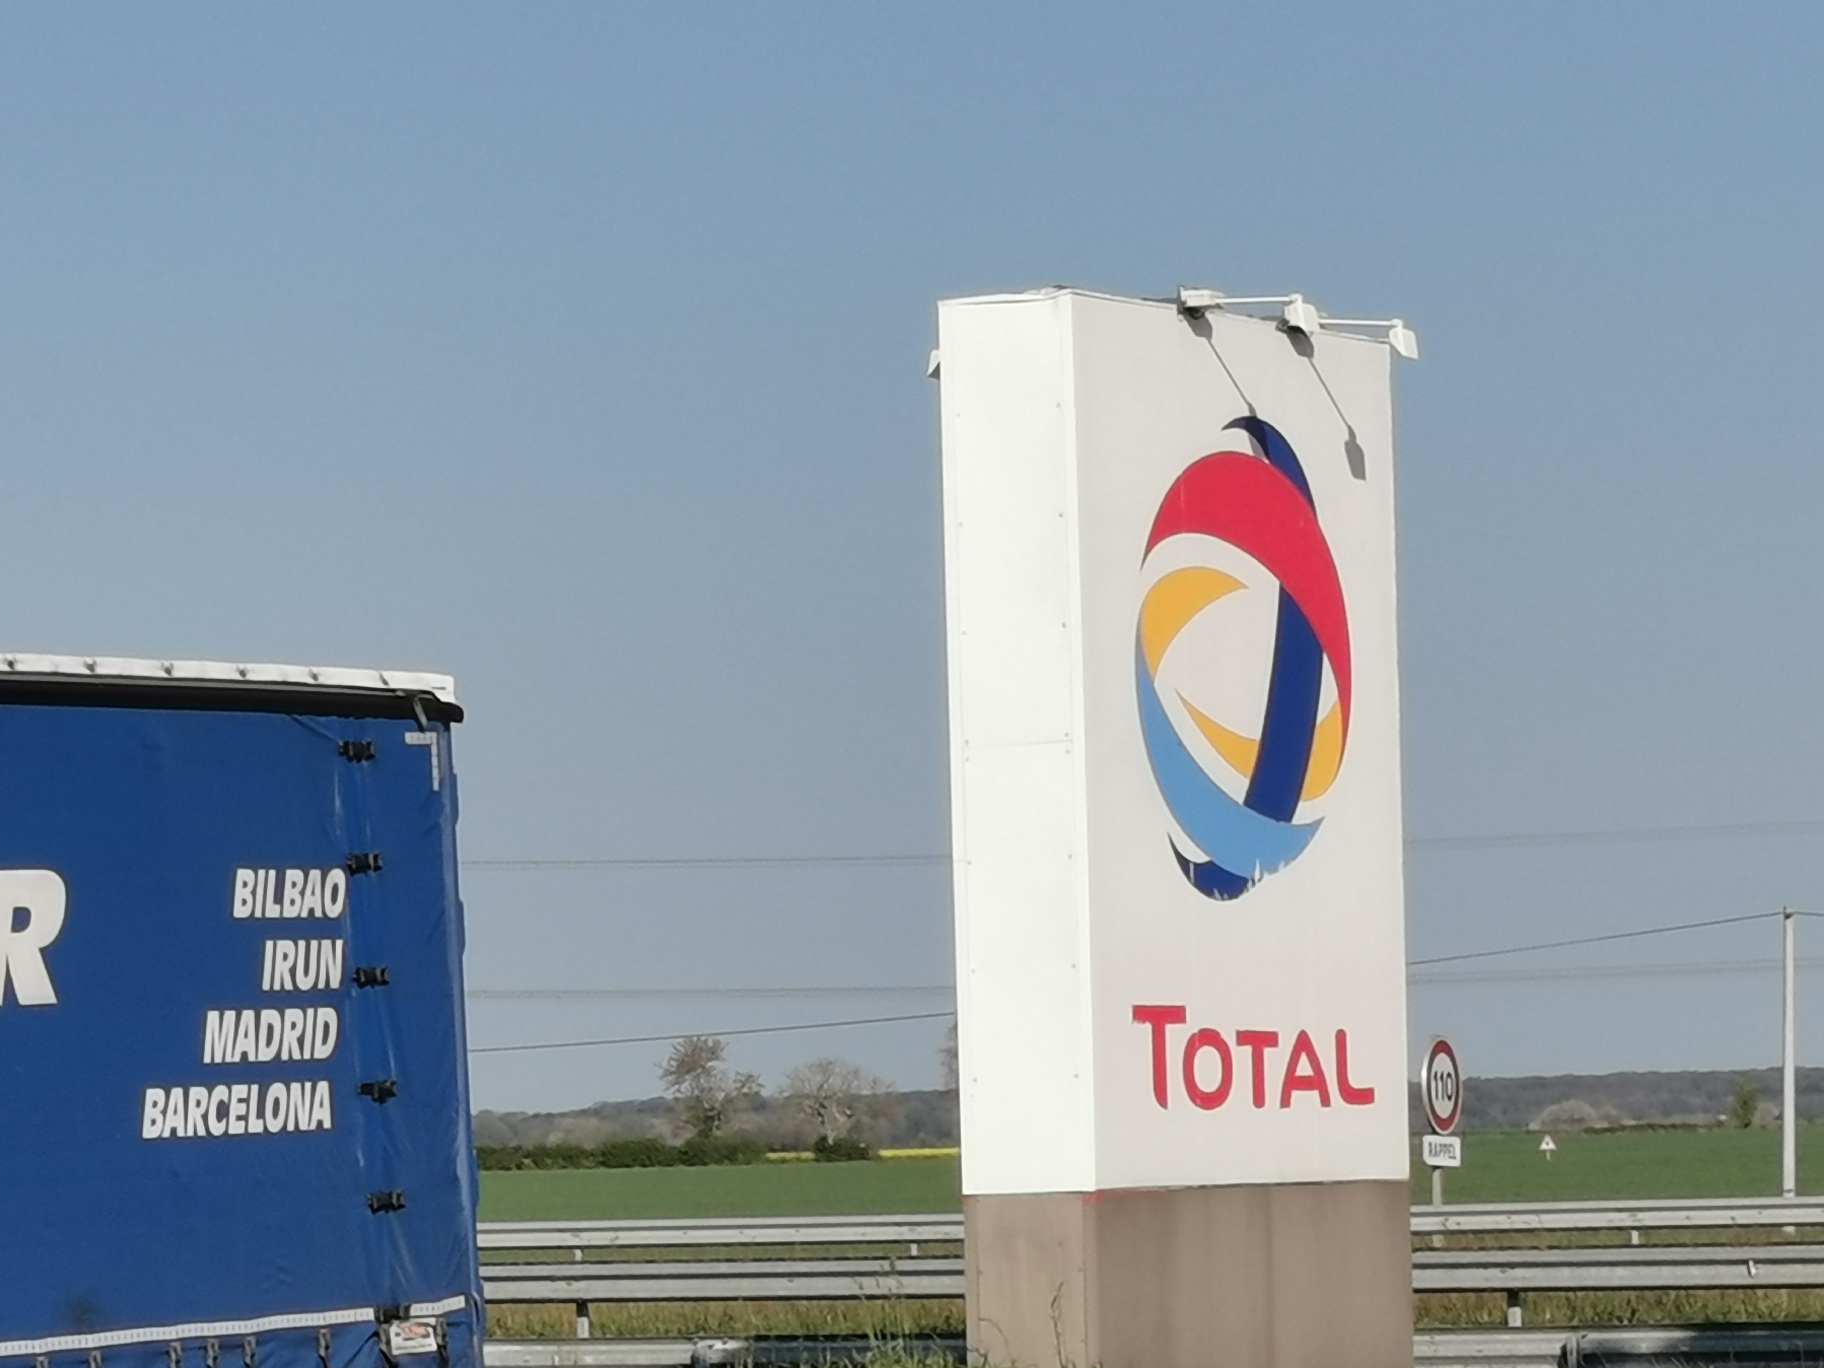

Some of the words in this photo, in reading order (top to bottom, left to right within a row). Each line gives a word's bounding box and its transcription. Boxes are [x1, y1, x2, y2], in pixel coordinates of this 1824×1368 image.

[232, 867, 347, 918] BILBAO
[261, 939, 344, 991] IRUN
[203, 1007, 338, 1064] MADRID
[141, 1080, 332, 1139] BARCELONA
[1432, 1070, 1454, 1102] 110
